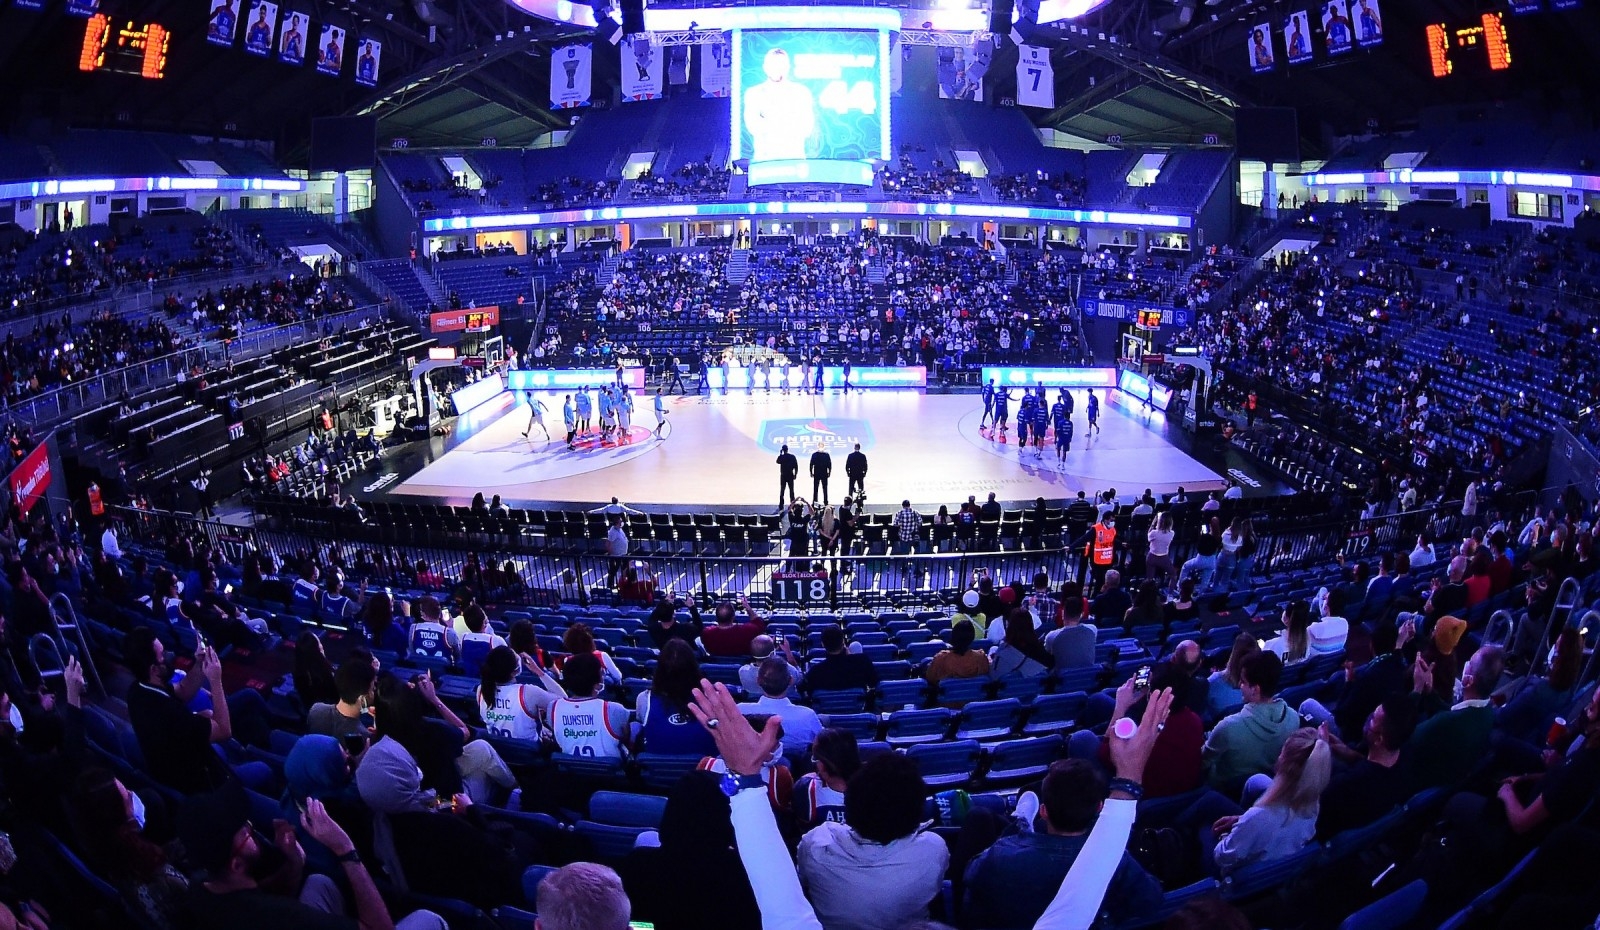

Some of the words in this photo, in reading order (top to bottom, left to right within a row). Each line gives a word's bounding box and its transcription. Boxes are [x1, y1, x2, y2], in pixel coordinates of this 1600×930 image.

[1027, 68, 1042, 92] 7
[819, 81, 876, 114] 44
[999, 98, 1015, 107] 403
[391, 140, 408, 149] 409
[481, 138, 497, 147] 408
[1106, 135, 1121, 144] 402
[1203, 136, 1218, 145] 401
[1098, 302, 1125, 319] DUNSTON
[545, 326, 558, 335] 107
[637, 323, 651, 333] 106
[793, 321, 806, 330] 105
[1059, 325, 1072, 333] 103
[230, 426, 244, 440] 112
[773, 434, 859, 444] ANADOLU
[1413, 451, 1427, 468] 124
[220, 539, 244, 559] 117
[1345, 535, 1370, 554] 119
[777, 579, 826, 600] 118
[420, 631, 439, 641] TOLGA
[486, 711, 516, 723] Bilyoner
[562, 714, 594, 726] DUNSTON
[563, 728, 598, 740] Bilyoner
[826, 810, 846, 821] AH
